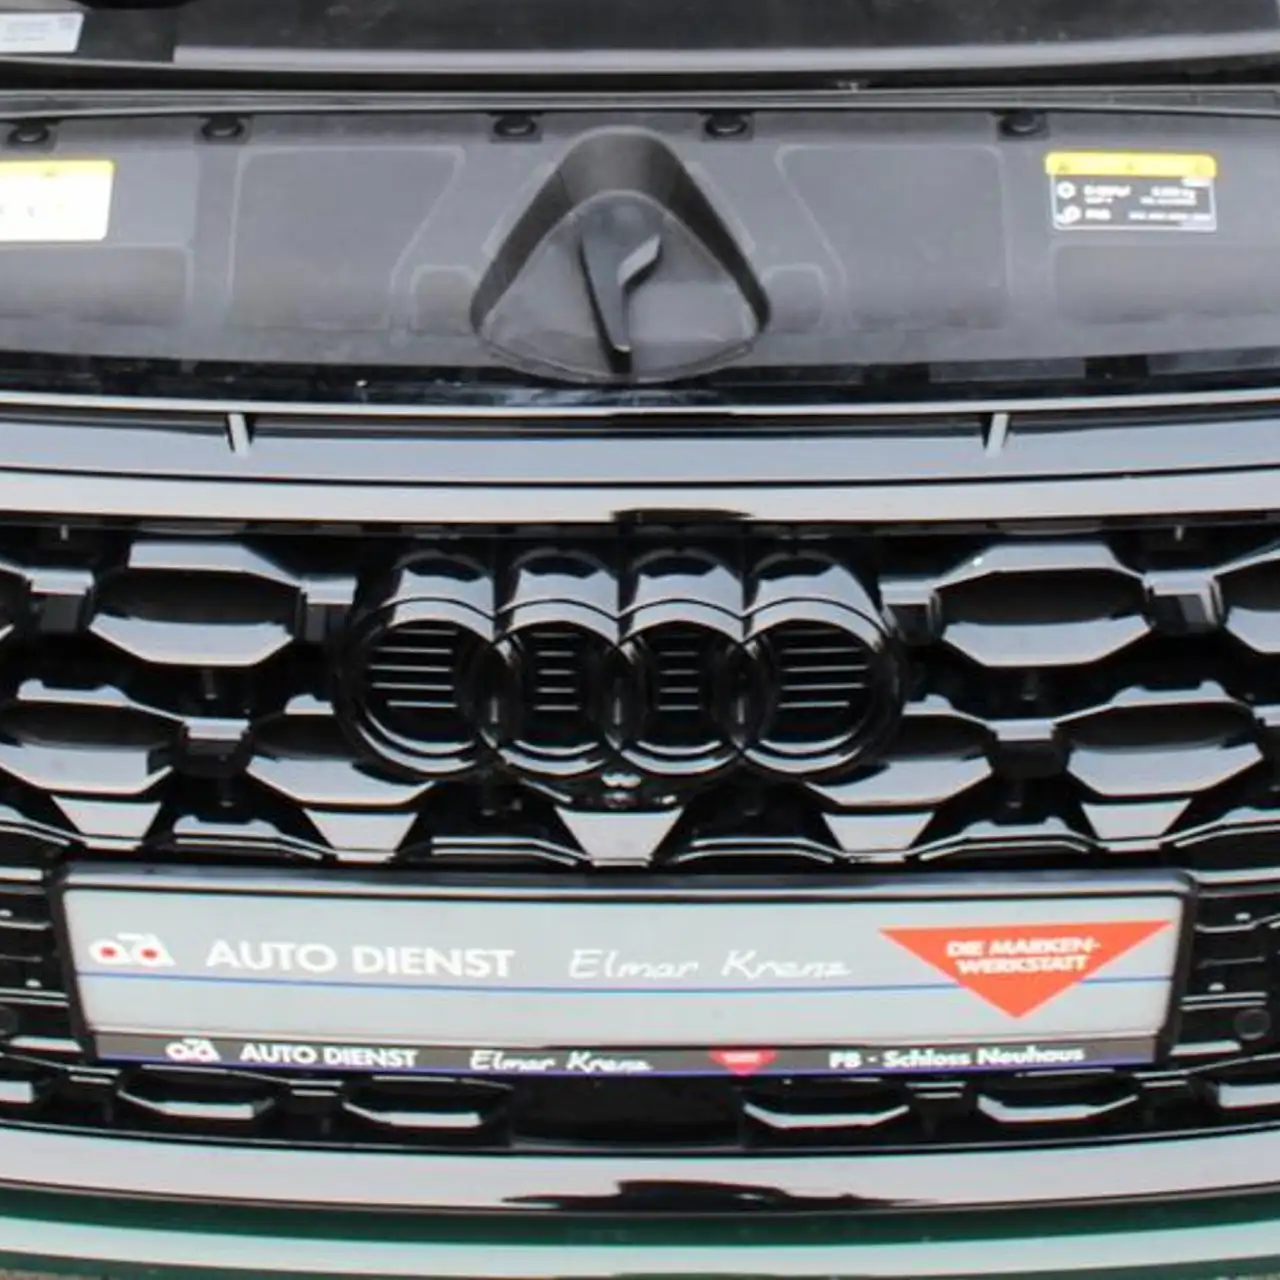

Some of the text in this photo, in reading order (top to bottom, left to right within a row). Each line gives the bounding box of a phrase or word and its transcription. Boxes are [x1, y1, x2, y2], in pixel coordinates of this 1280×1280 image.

[206, 939, 337, 973] AUTO
[352, 946, 516, 978] DIENST
[569, 948, 699, 979] Elmar
[955, 955, 1089, 975] WERKSTATT
[239, 1043, 318, 1065] AUTO
[324, 1045, 418, 1068] DIENST
[469, 1049, 556, 1071] Elmar
[883, 1047, 971, 1068] Schloss
[977, 1046, 1086, 1066] Neuhaus
